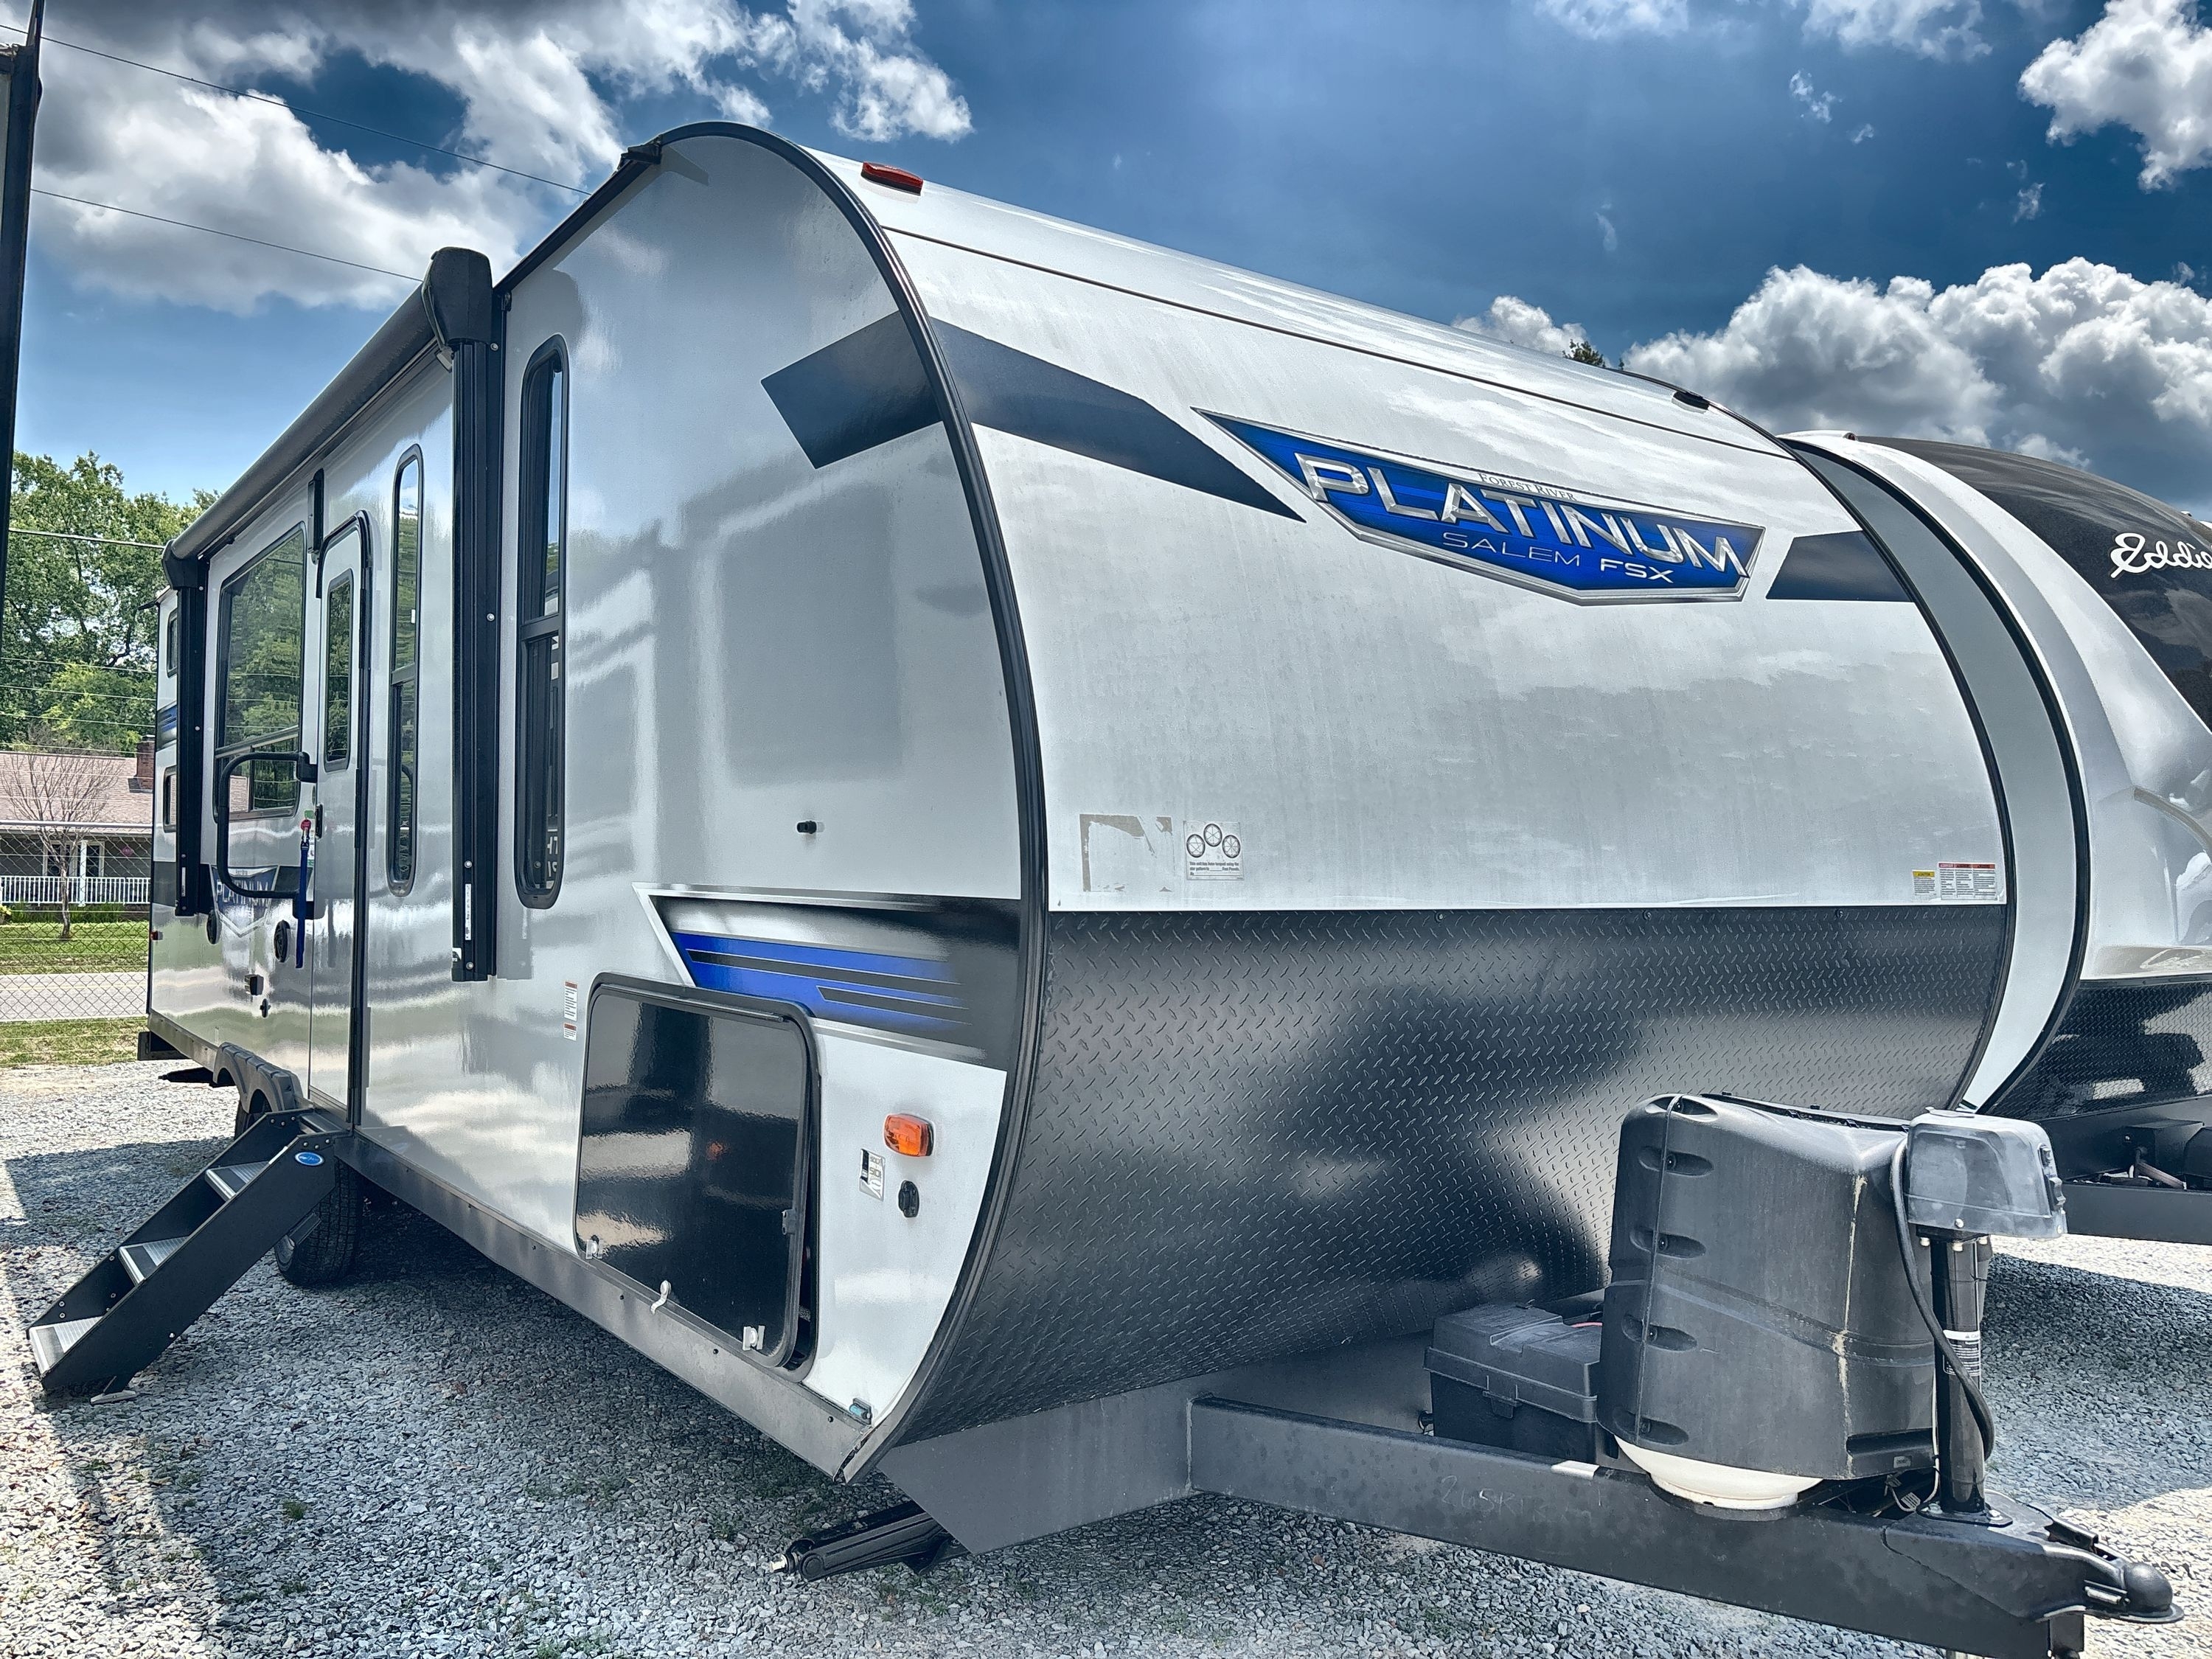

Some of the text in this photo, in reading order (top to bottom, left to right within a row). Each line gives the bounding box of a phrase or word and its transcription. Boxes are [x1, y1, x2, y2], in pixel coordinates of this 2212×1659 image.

[1478, 473, 1577, 501] FOREST RIVER
[1294, 452, 1750, 578] PLATINUM
[1442, 532, 1674, 583] SALEM FSX
